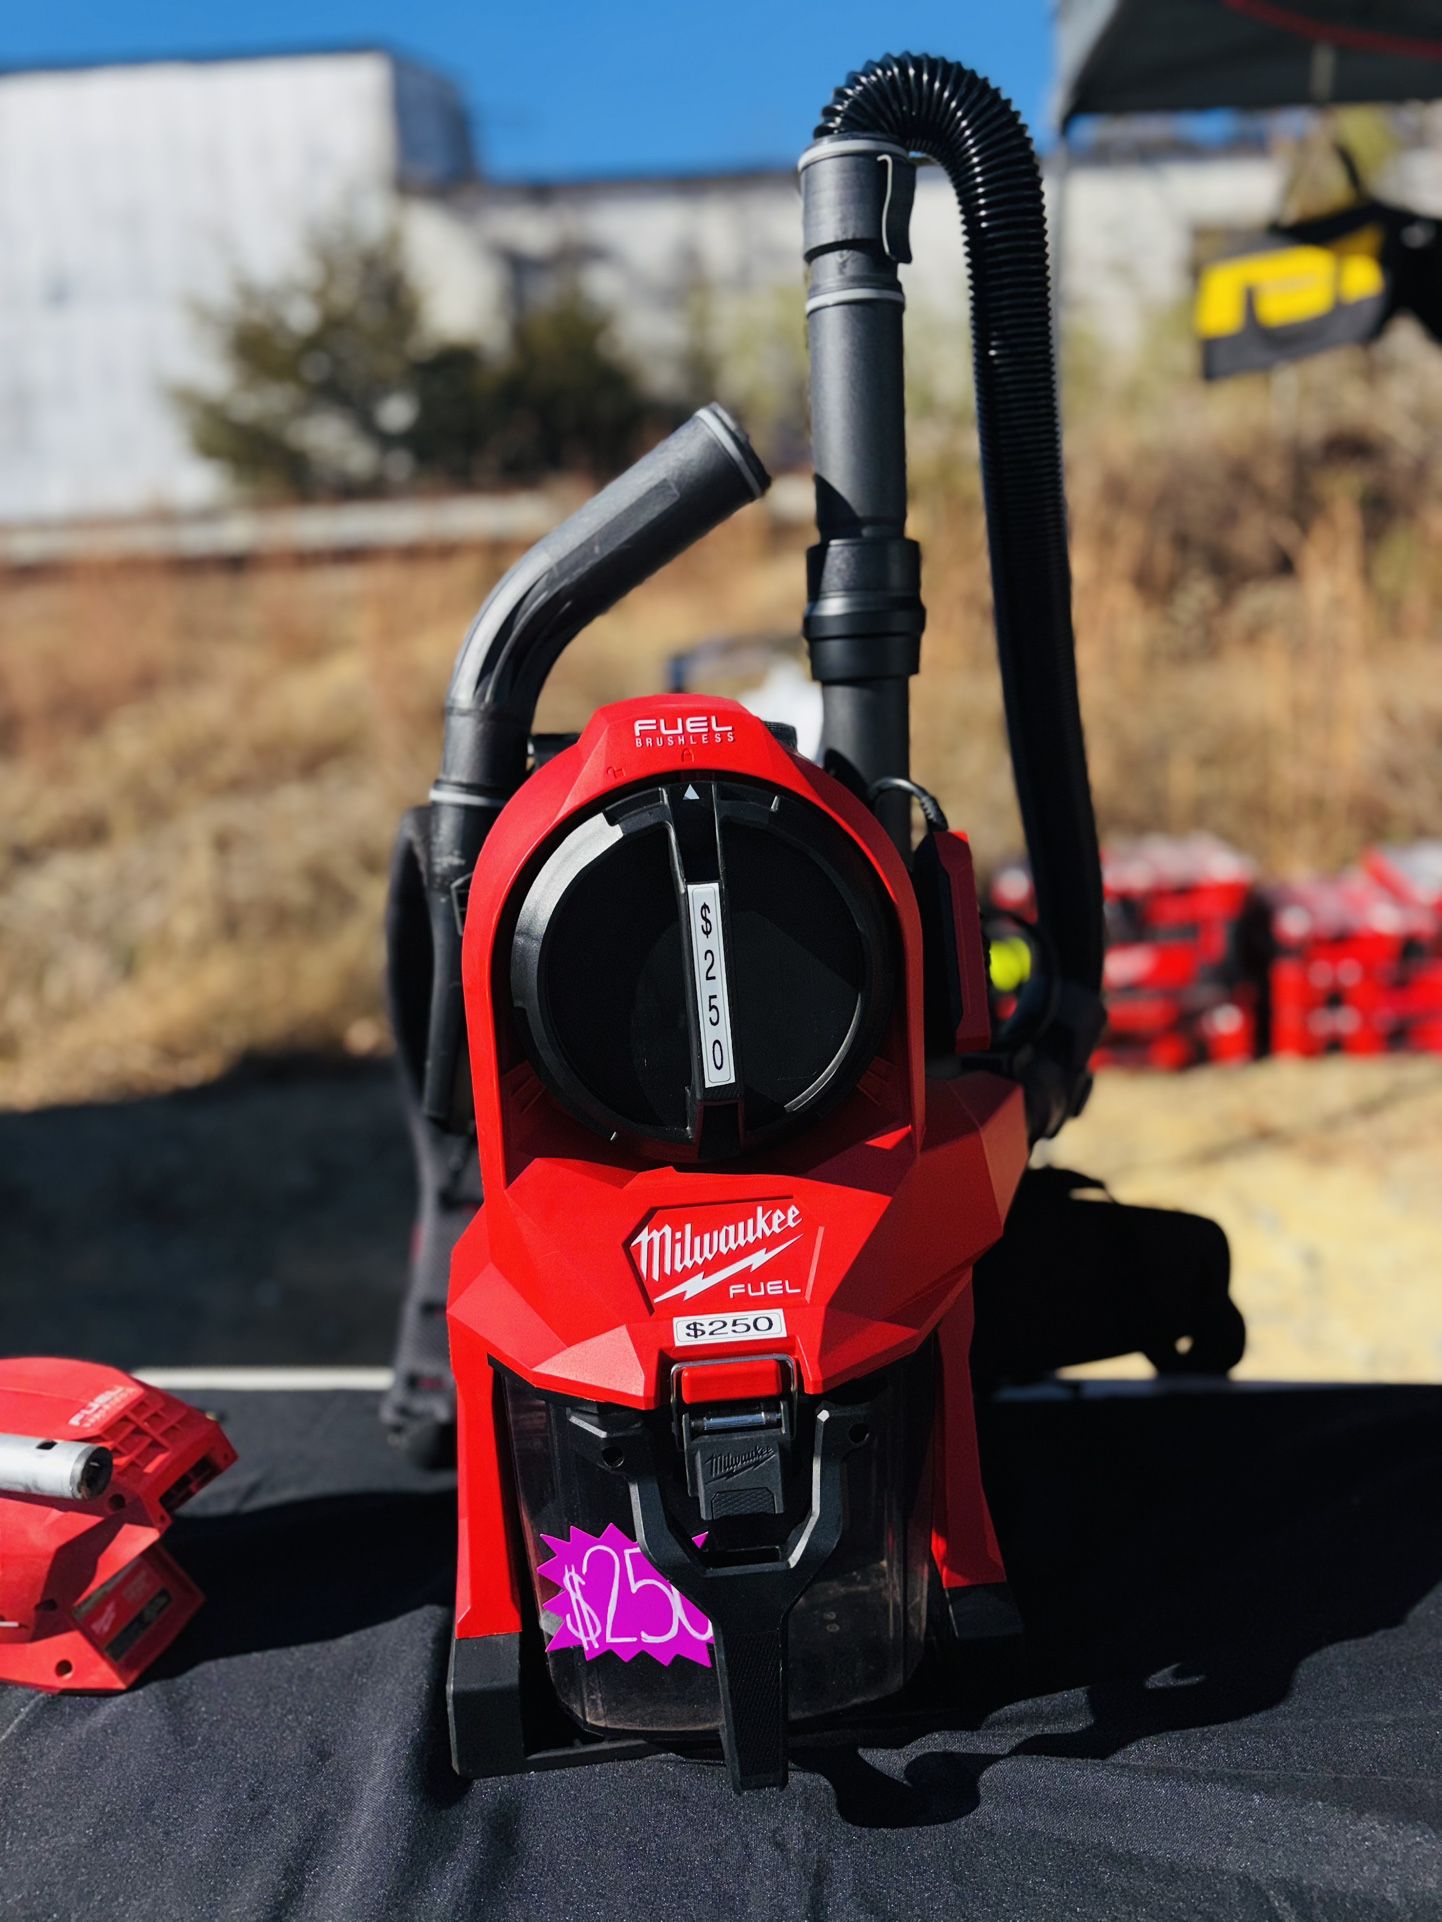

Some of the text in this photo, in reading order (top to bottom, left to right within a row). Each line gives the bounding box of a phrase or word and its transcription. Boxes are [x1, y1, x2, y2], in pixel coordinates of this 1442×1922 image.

[633, 715, 733, 737] FUEL
[635, 732, 735, 748] BRUSHLESS
[700, 902, 724, 1071] $250
[630, 1204, 803, 1282] Milwaukee
[728, 1279, 802, 1299] FUEL
[685, 1316, 774, 1339] $250
